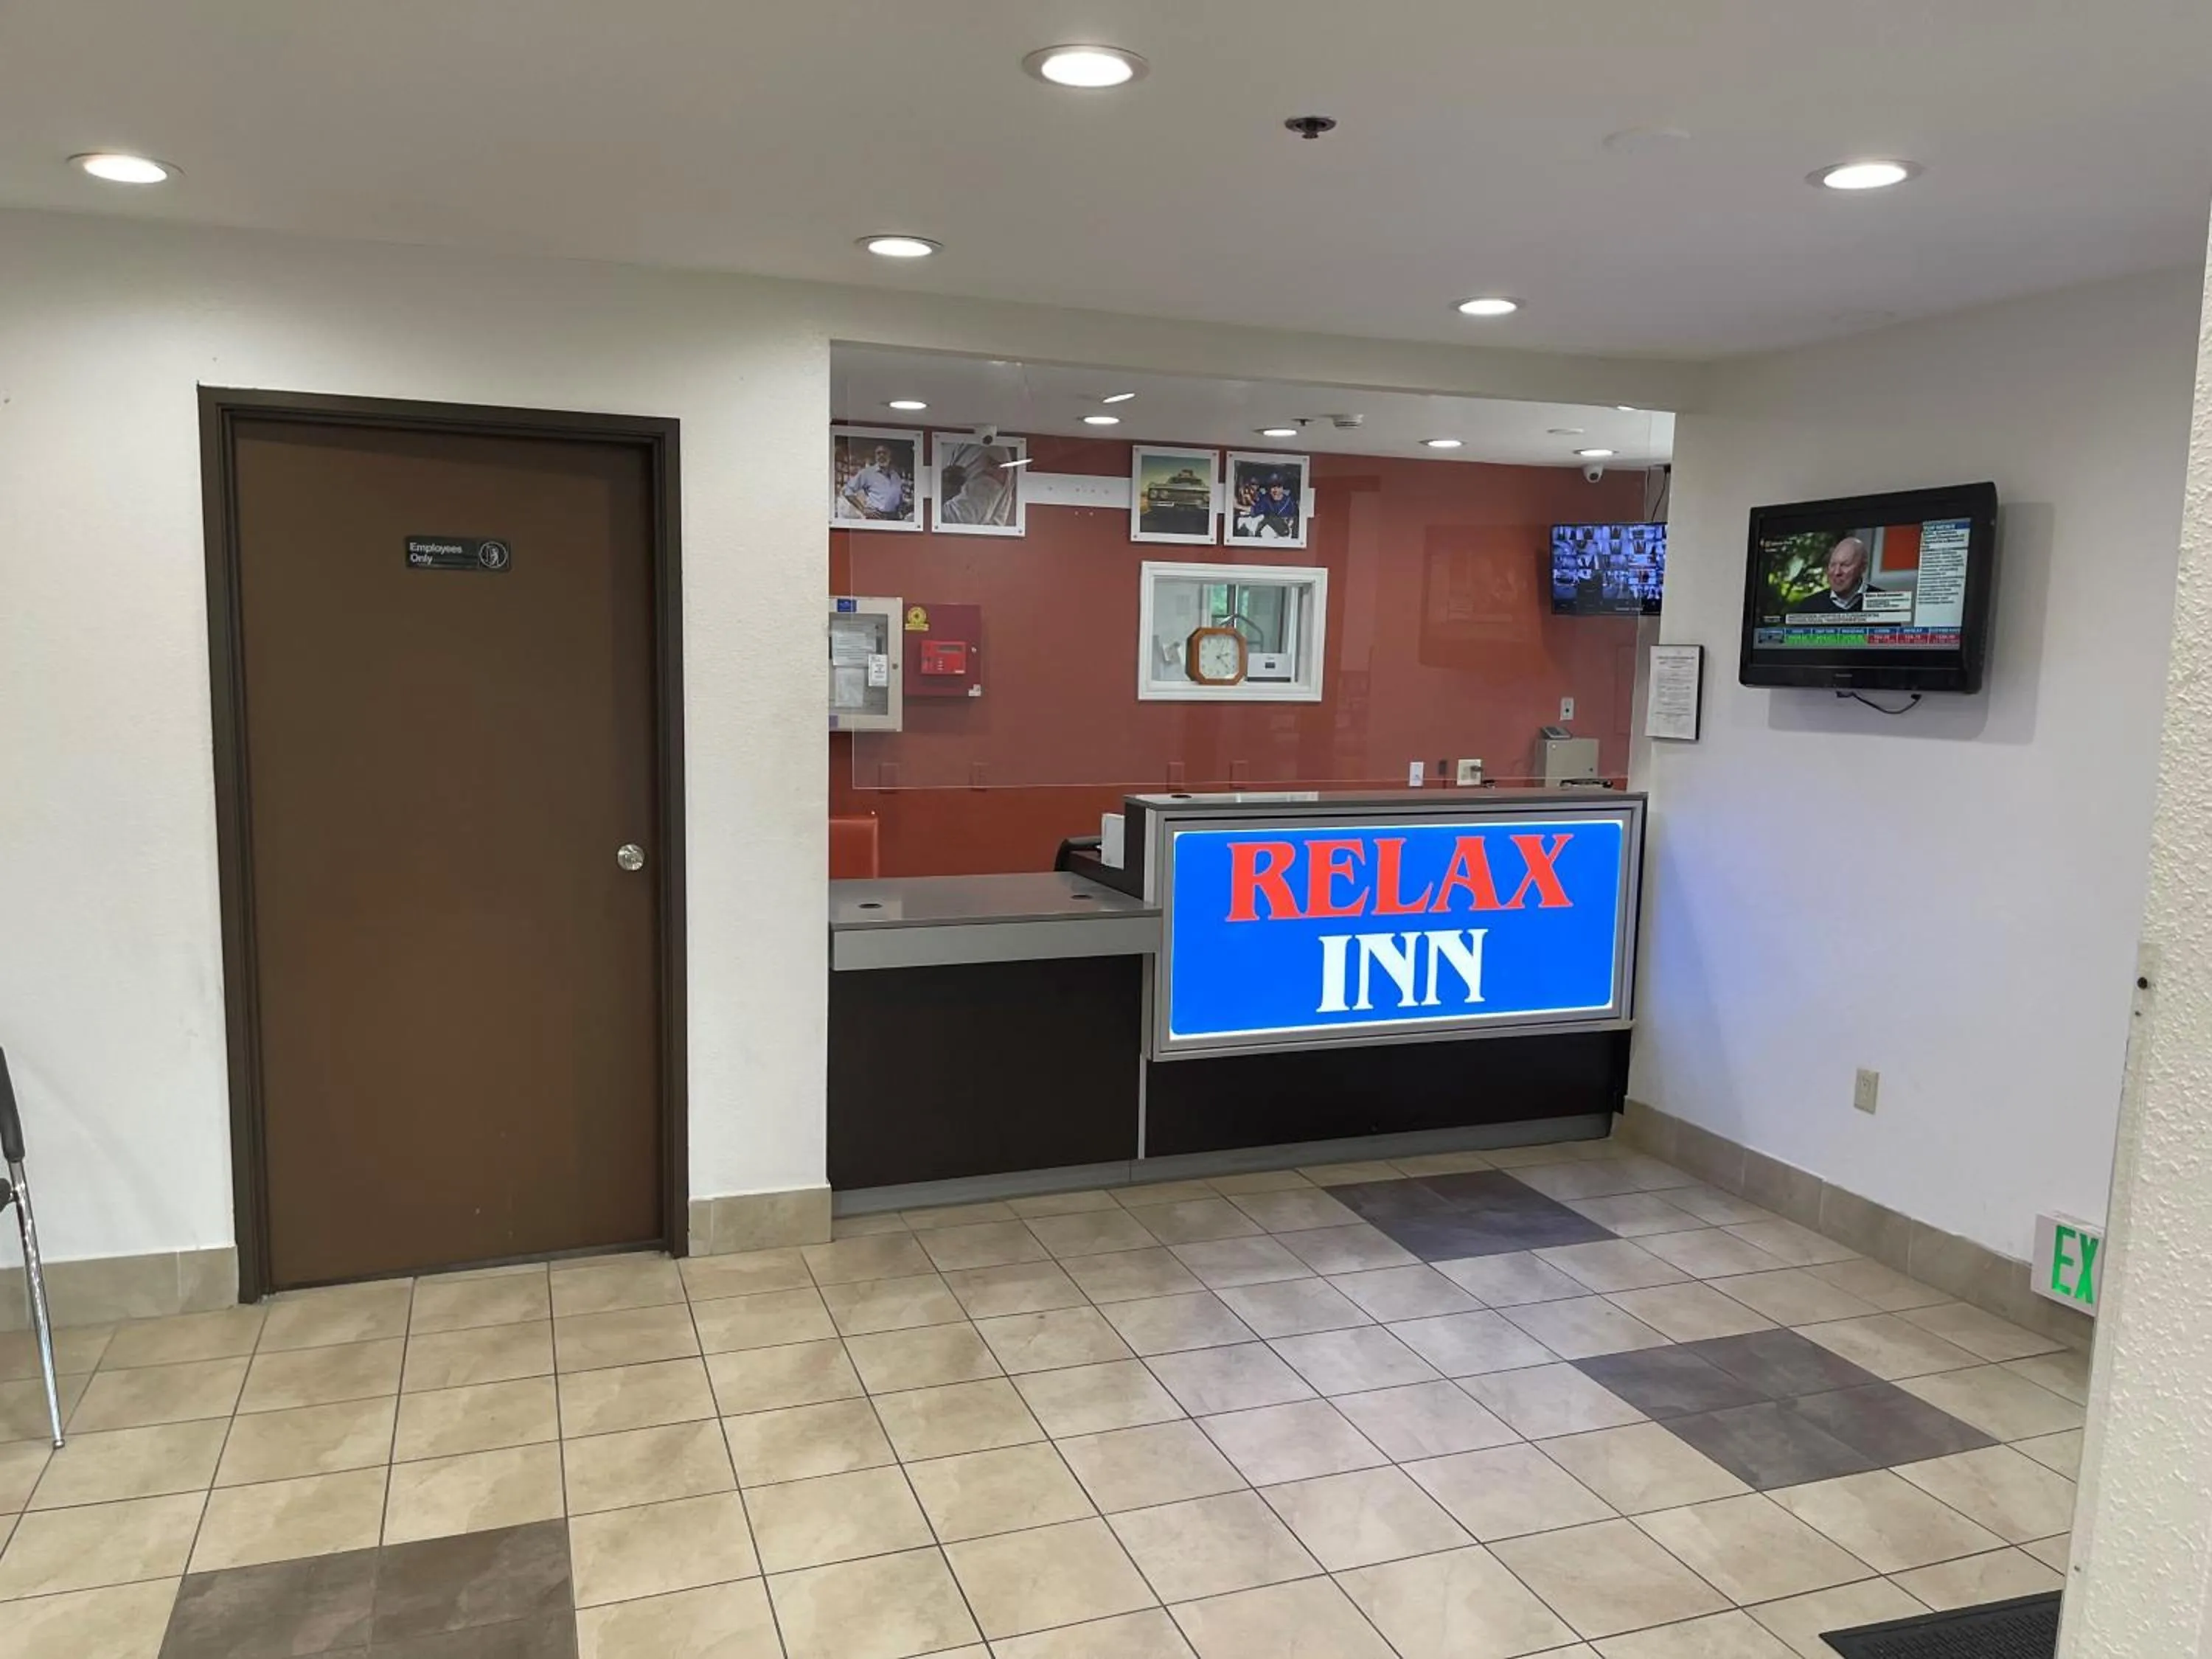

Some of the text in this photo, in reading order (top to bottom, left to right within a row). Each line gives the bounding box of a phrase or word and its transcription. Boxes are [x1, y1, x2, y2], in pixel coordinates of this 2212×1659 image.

[409, 542, 462, 554] Employees
[410, 552, 433, 565] Only
[1225, 834, 1574, 922] RELAX
[1316, 928, 1489, 1013] INN
[2051, 1224, 2099, 1304] EX
